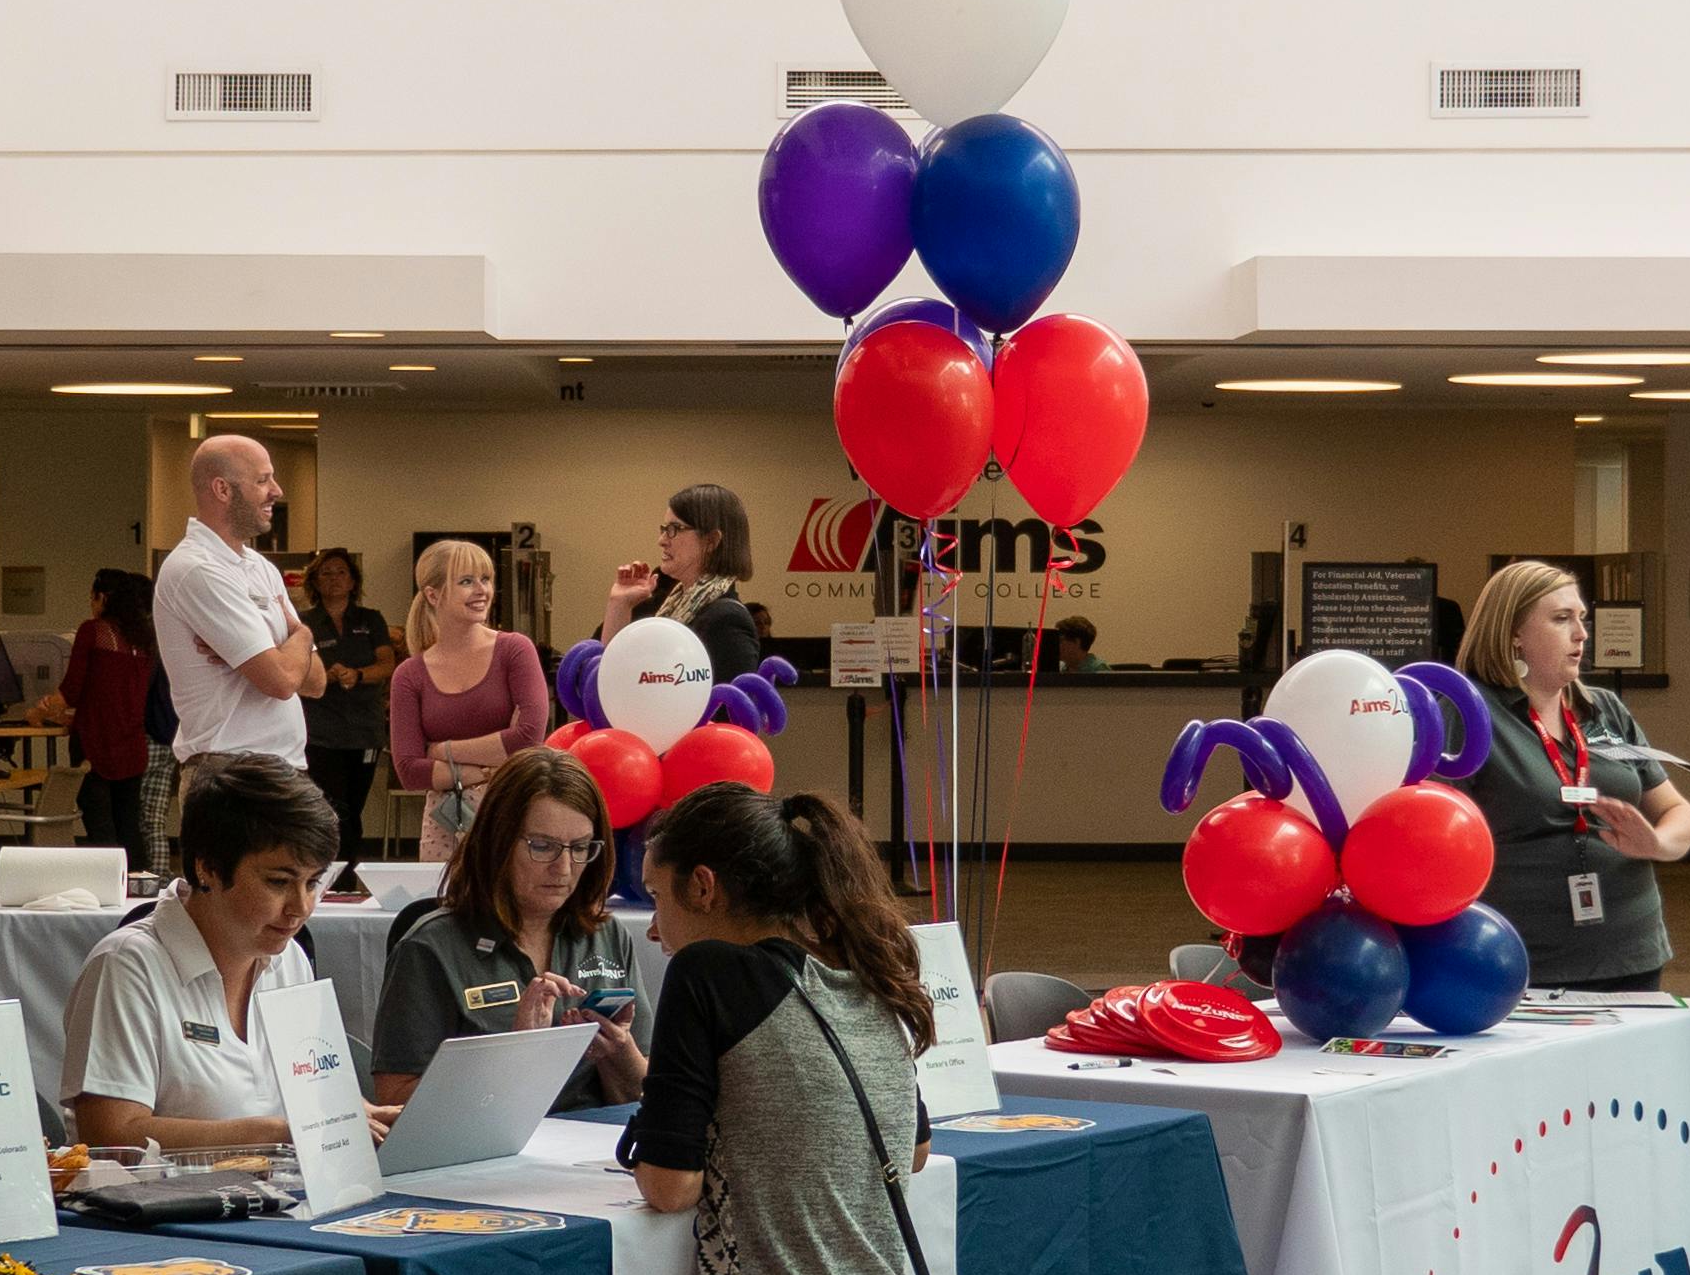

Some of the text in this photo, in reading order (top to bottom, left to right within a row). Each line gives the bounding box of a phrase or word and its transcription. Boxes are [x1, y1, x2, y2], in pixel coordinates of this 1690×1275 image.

[517, 524, 536, 549] 2
[899, 525, 916, 549] 3
[1289, 524, 1307, 549] 4
[1312, 593, 1360, 603] Scholarship
